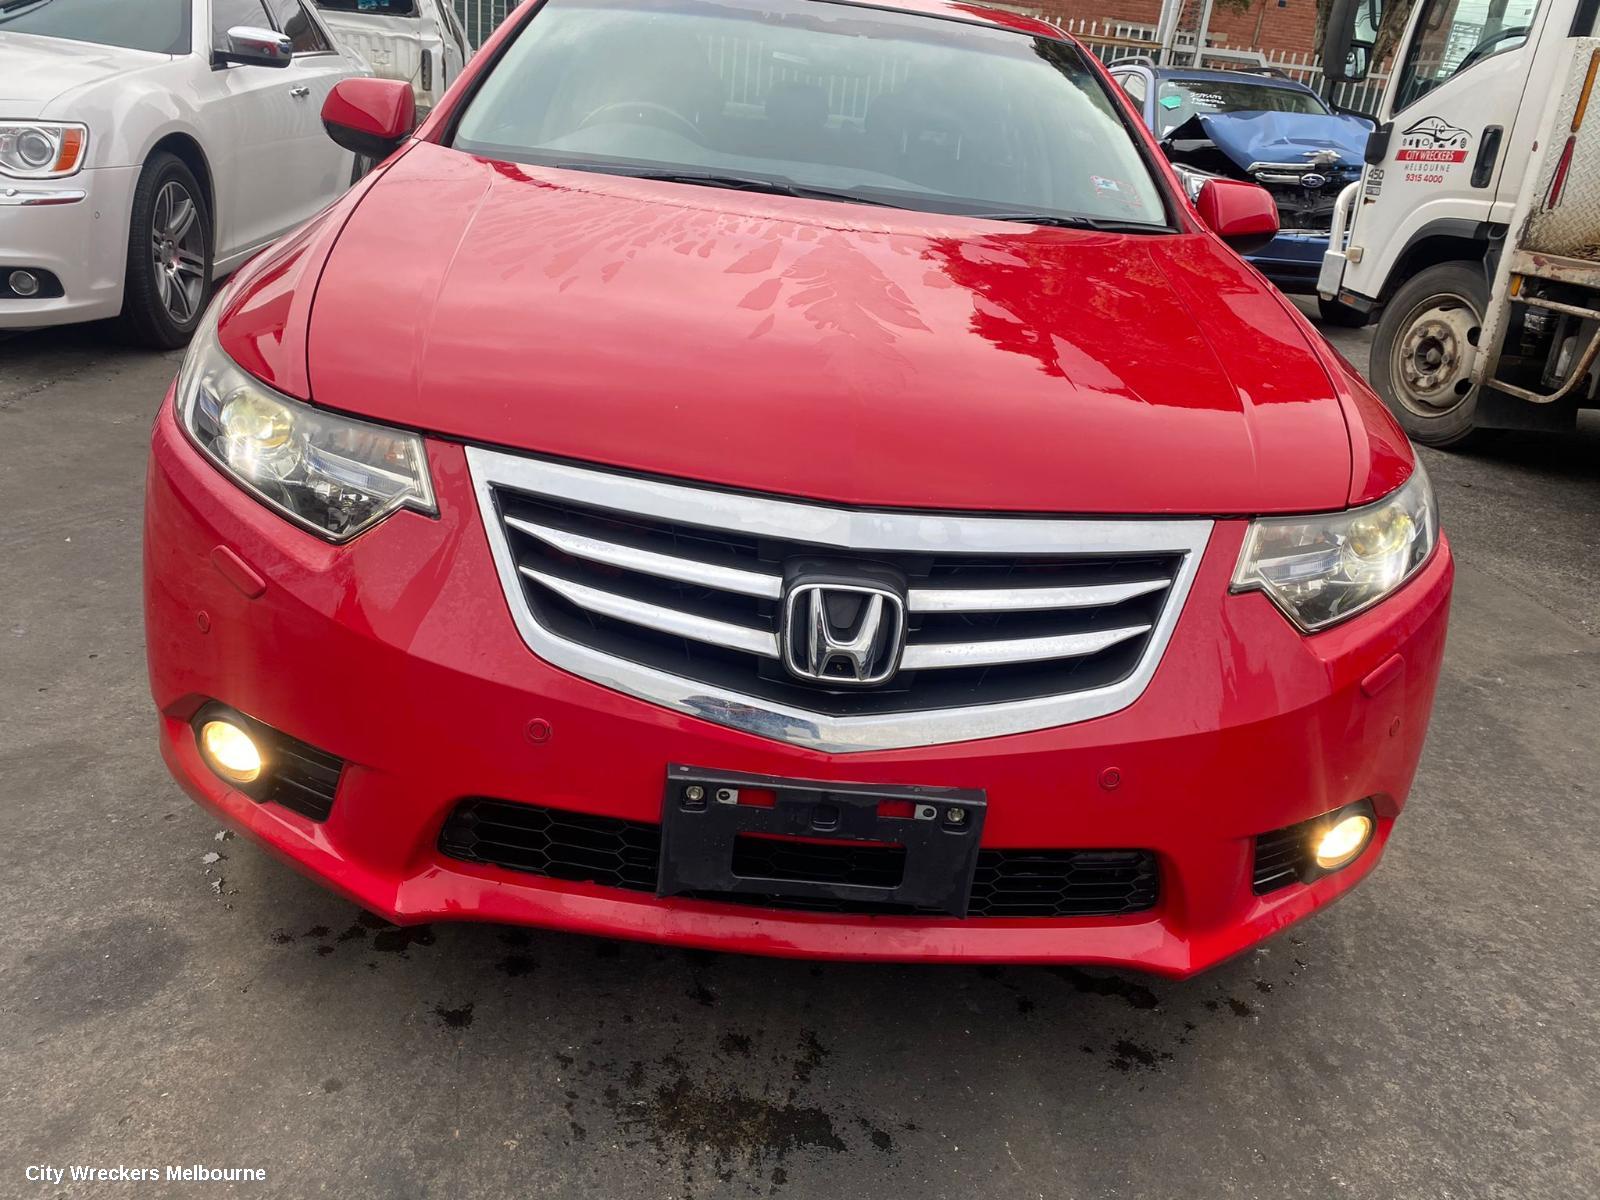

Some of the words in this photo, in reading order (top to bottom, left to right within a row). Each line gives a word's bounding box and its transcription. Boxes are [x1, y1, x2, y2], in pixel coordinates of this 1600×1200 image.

[1405, 150, 1418, 160] CITY
[1420, 150, 1454, 161] WRECKERS
[1404, 163, 1450, 173] MELBOURNE
[1368, 168, 1384, 179] 450
[1405, 173, 1422, 182] 9315
[1423, 174, 1443, 183] 4000
